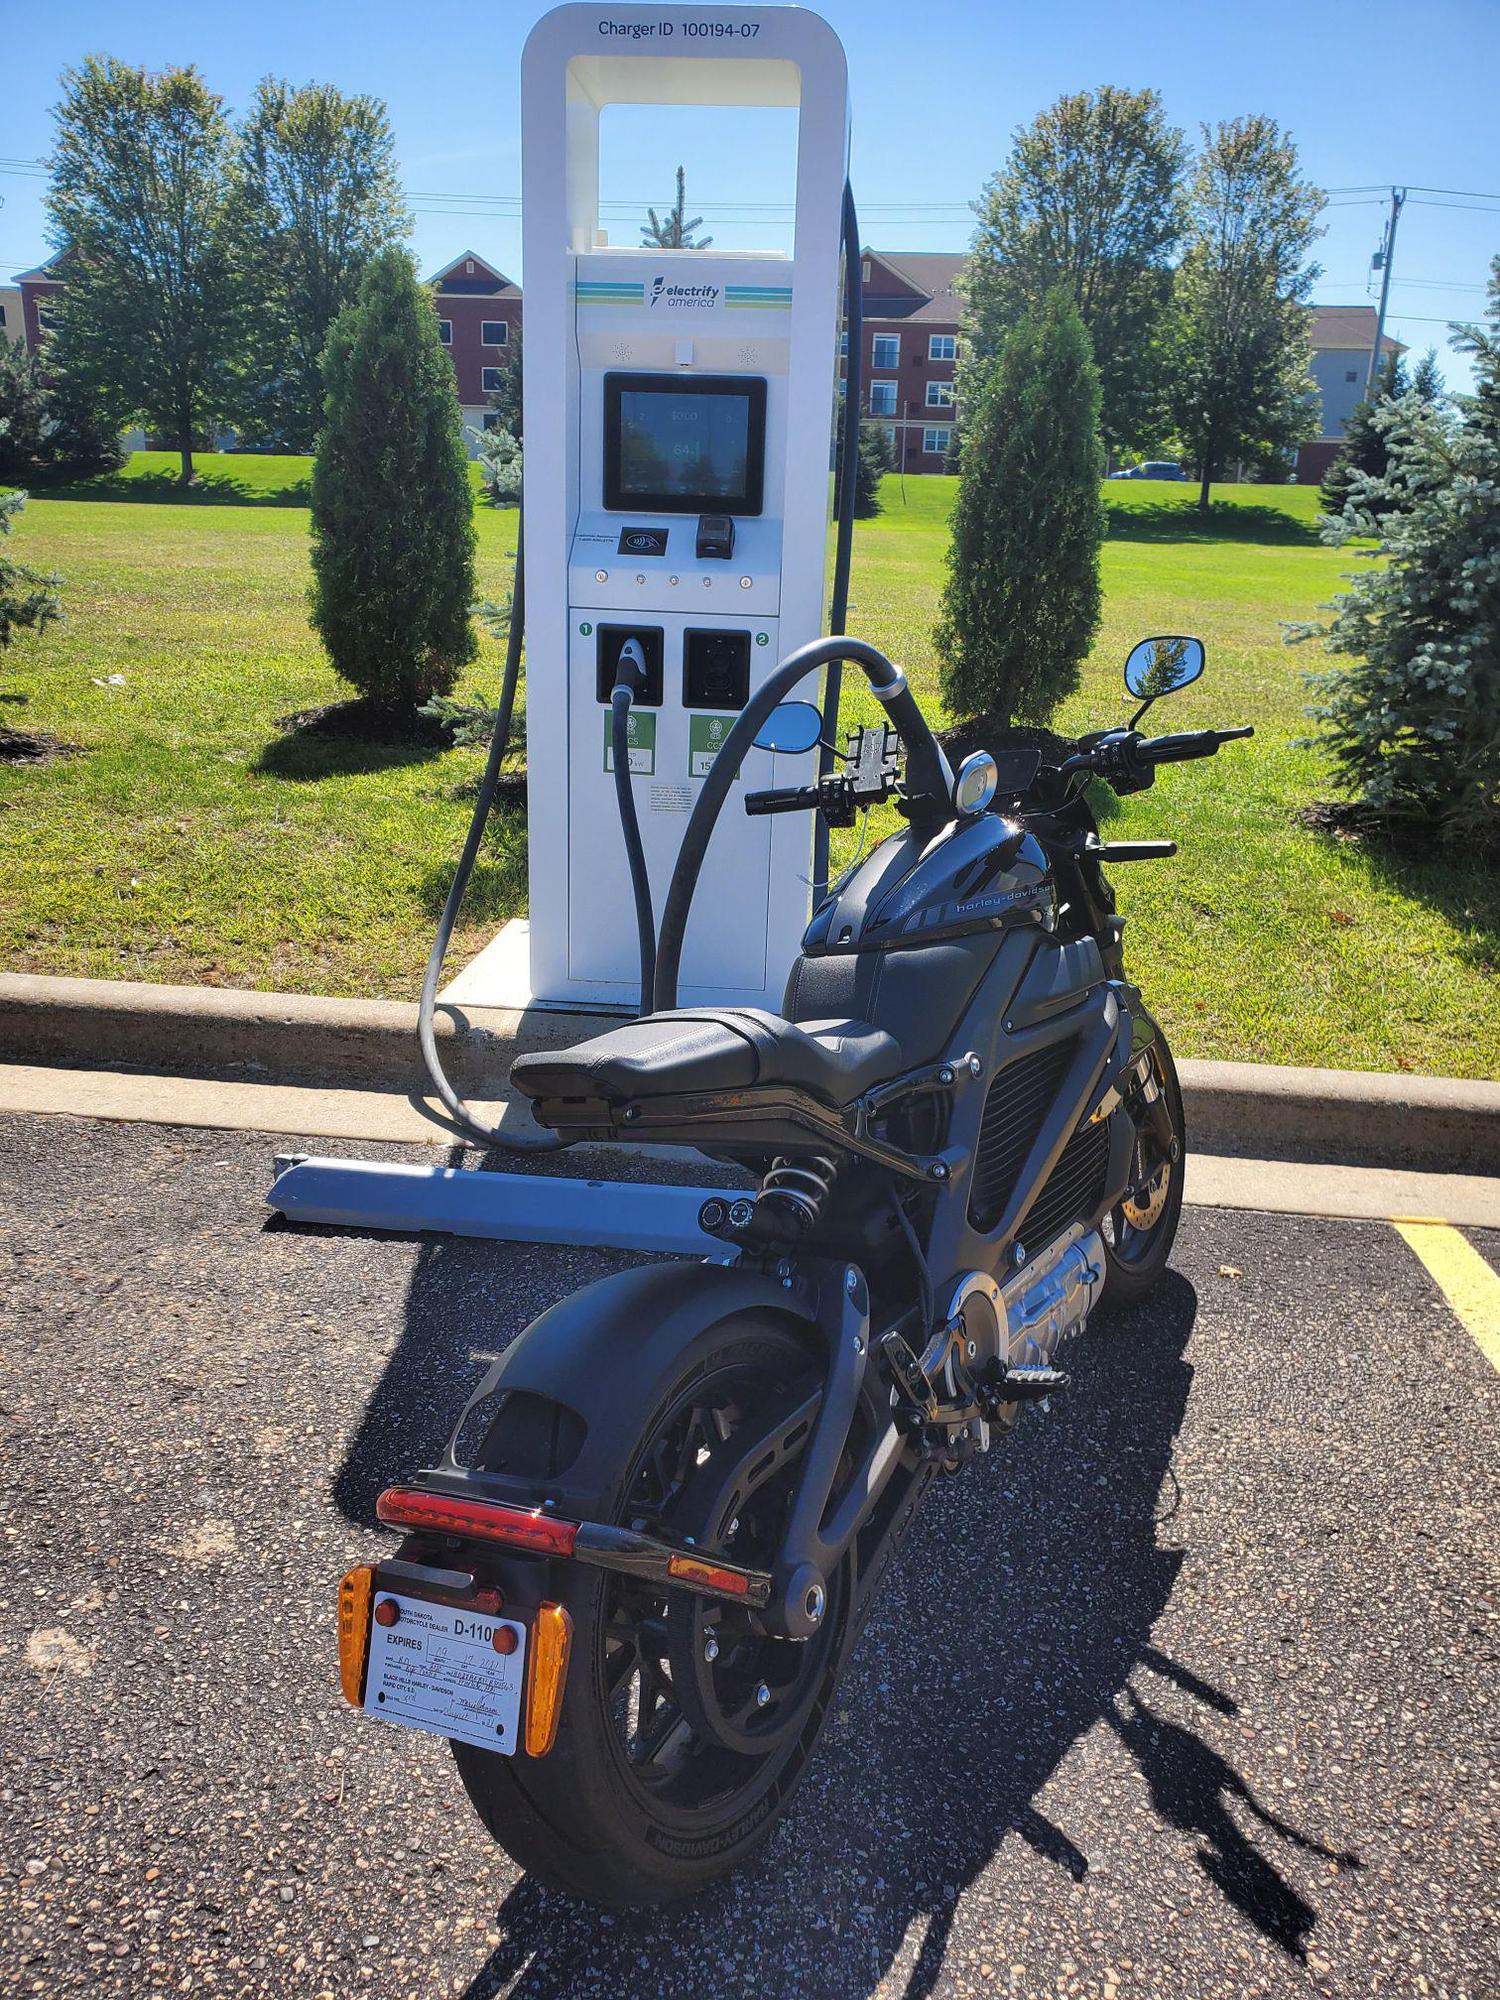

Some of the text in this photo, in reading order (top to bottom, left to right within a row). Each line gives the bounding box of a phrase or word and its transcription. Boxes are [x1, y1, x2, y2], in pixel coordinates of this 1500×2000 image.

[598, 21, 760, 39] Charger ID 100194-07
[666, 285, 720, 299] electrify
[667, 297, 715, 308] america
[627, 737, 639, 745] CS
[700, 762, 711, 771] 15
[399, 1608, 434, 1621] OUTH DAKOTA
[399, 1616, 448, 1632] OTORCYCLE DEALER
[454, 1619, 497, 1642] D-110
[387, 1633, 423, 1651] EXPIRES
